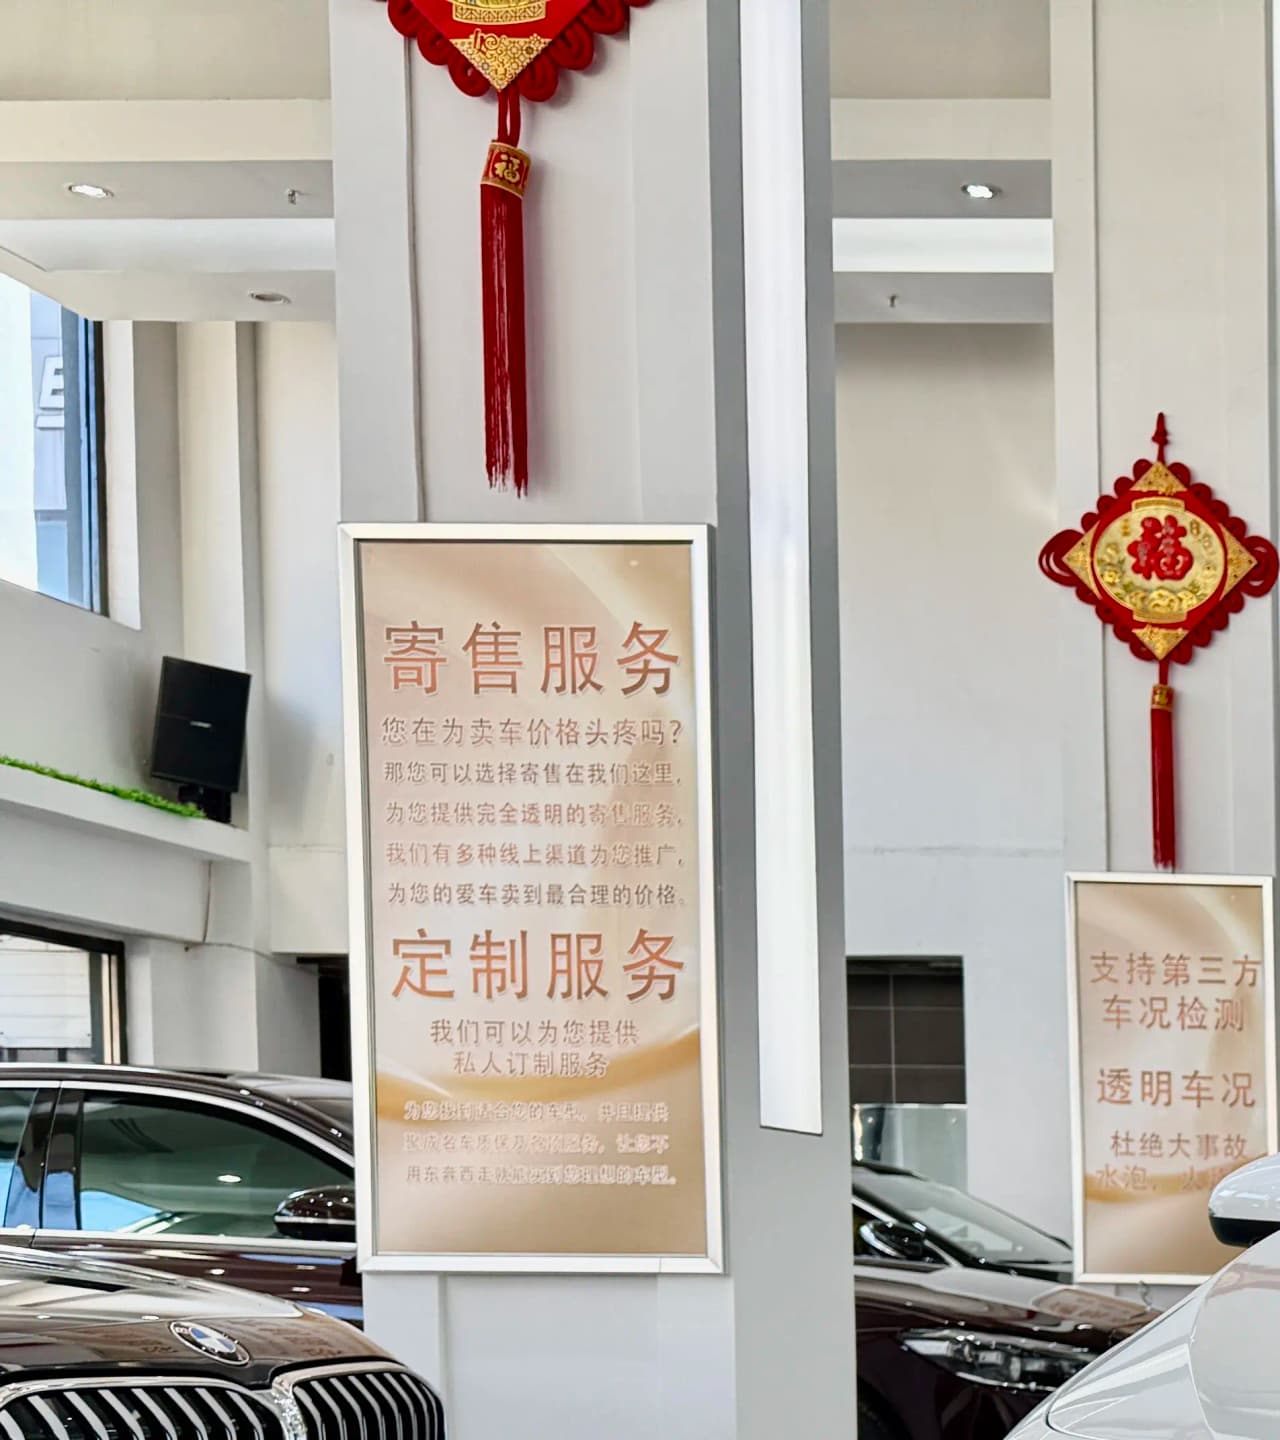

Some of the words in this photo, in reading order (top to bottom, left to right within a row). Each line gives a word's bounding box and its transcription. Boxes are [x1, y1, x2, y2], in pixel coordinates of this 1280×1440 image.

[1128, 515, 1193, 580] 福
[383, 620, 680, 695] 寄售服务
[381, 717, 683, 746] 您在为卖车价格头疼吗？
[391, 928, 685, 1000] 定制服务
[1089, 951, 1262, 988] 支持第三方
[1102, 993, 1246, 1032] 车况检测
[429, 1018, 640, 1046] 我们可以为您提供
[453, 1051, 609, 1078] 私人订制服务
[1097, 1067, 1257, 1109] 透明车况
[1110, 1130, 1248, 1160] 杜绝大事故
